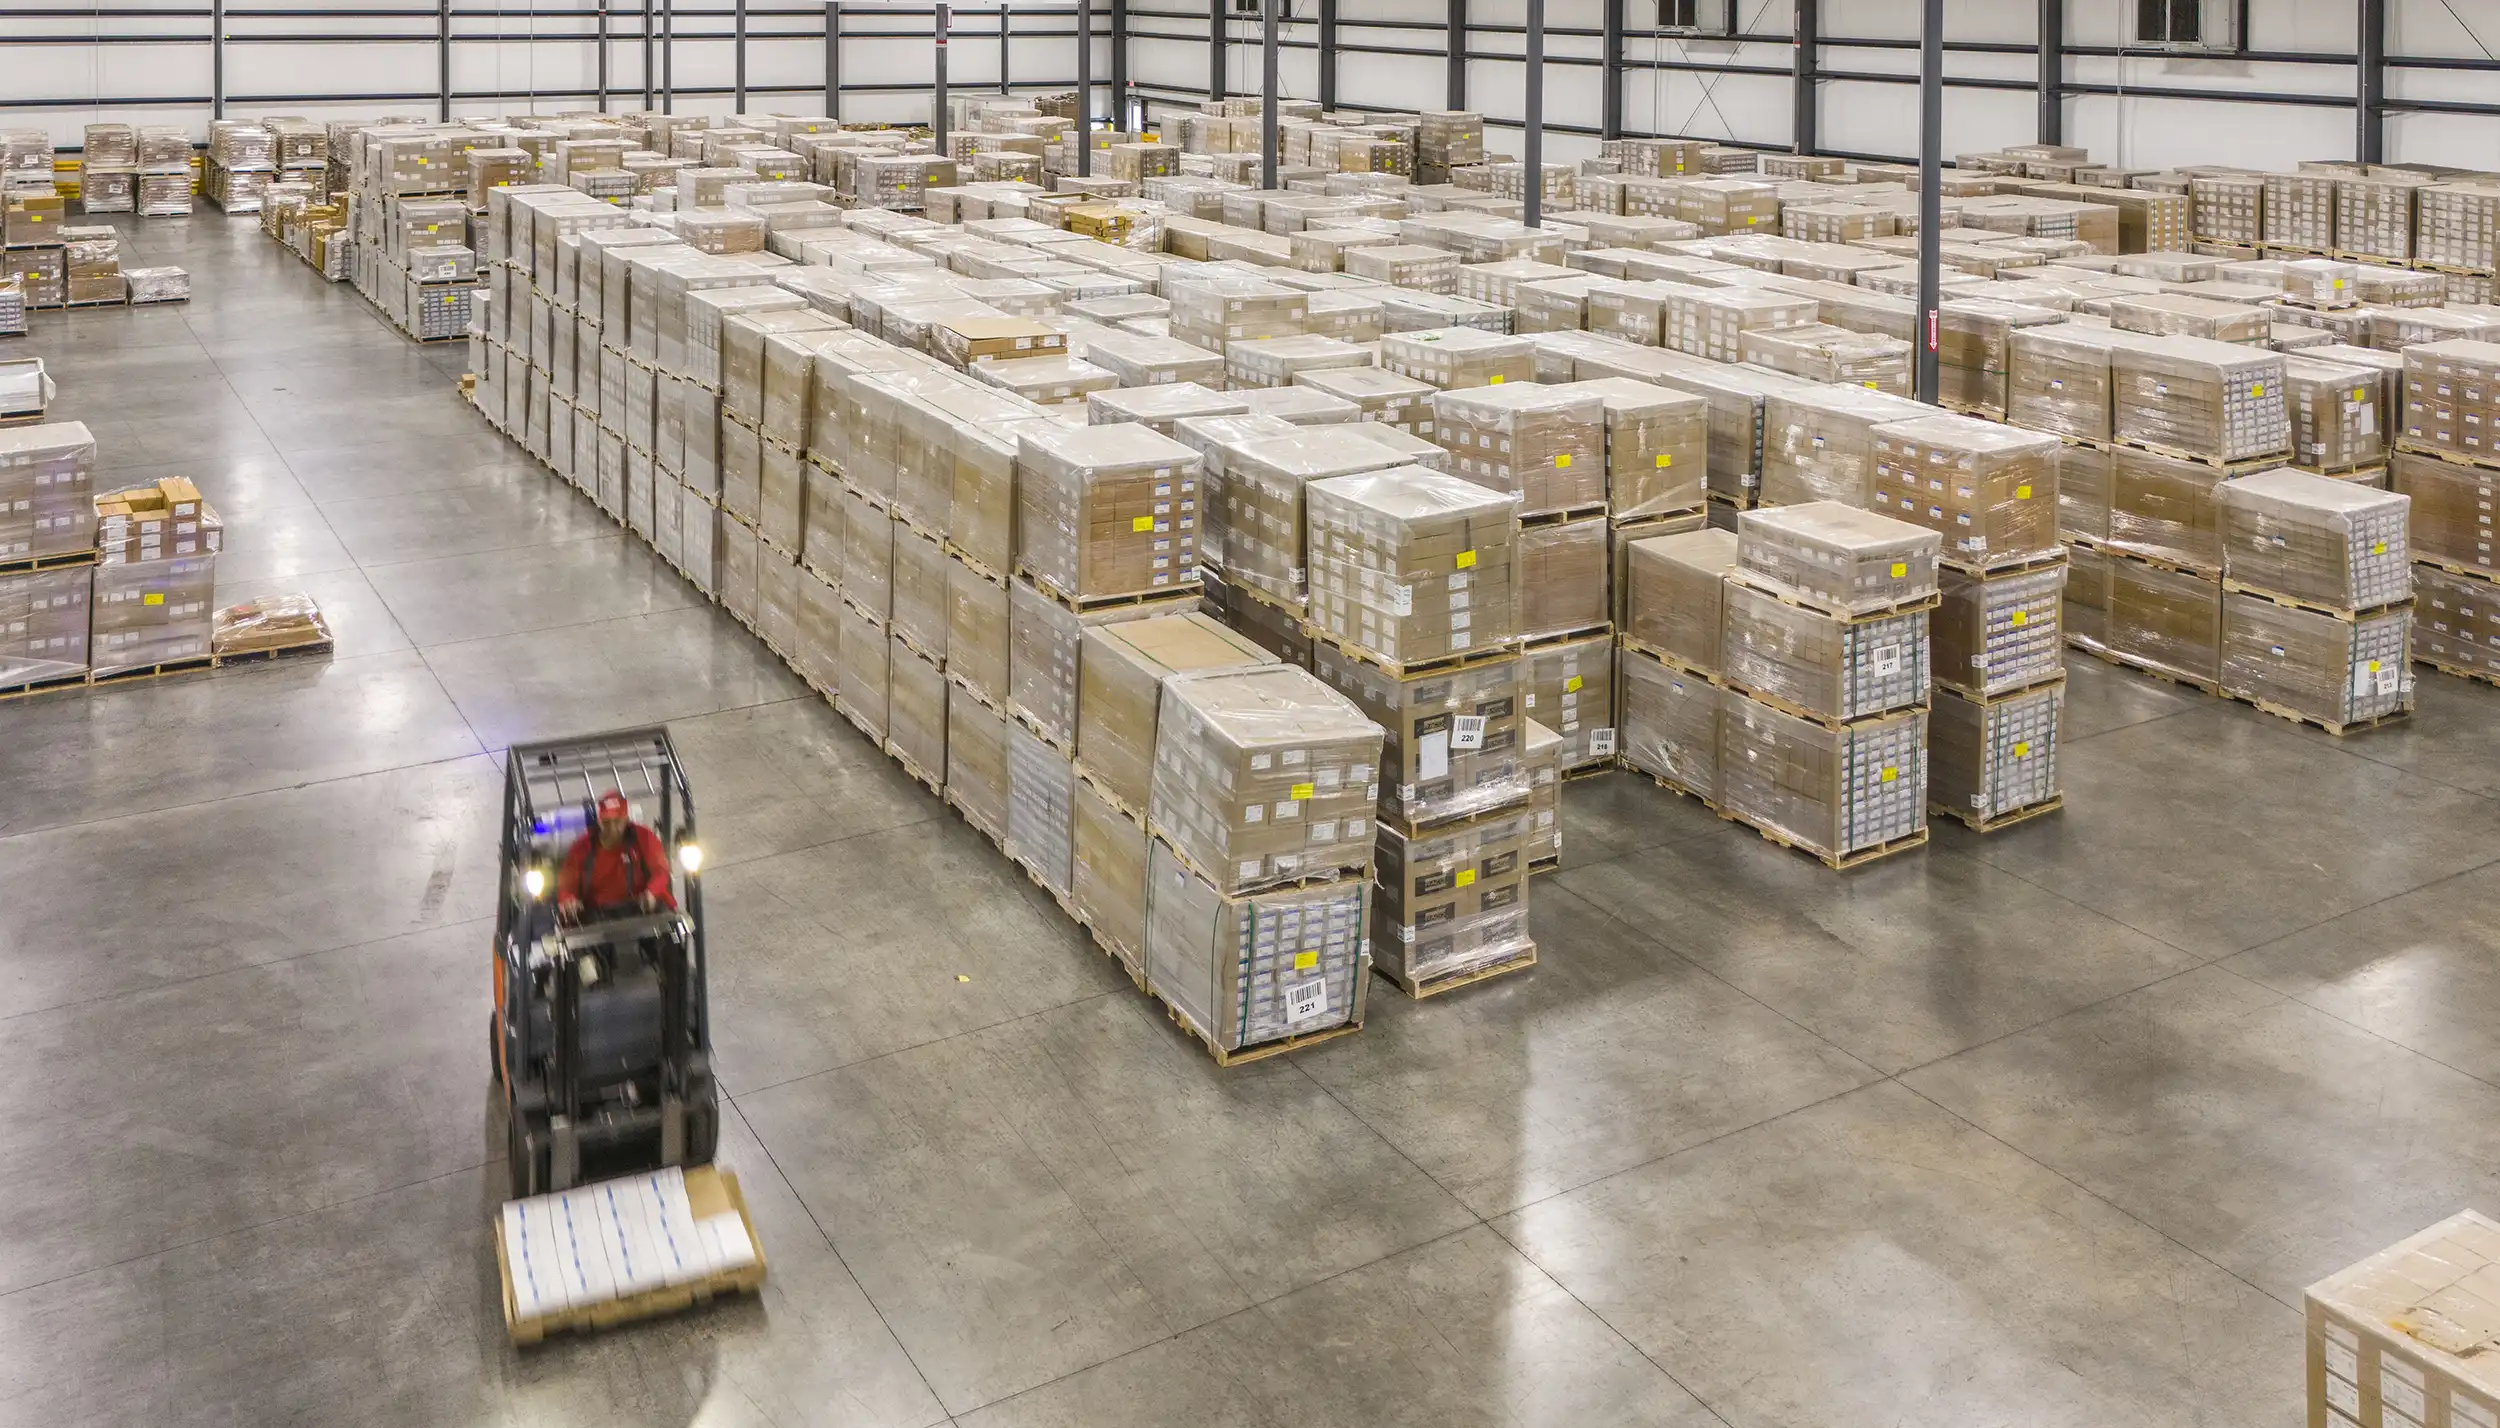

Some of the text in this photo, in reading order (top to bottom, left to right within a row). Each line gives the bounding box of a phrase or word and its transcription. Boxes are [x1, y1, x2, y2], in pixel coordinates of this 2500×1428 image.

[1881, 662, 1893, 670] 217
[1461, 734, 1475, 742] 220
[1299, 1002, 1315, 1014] 221
